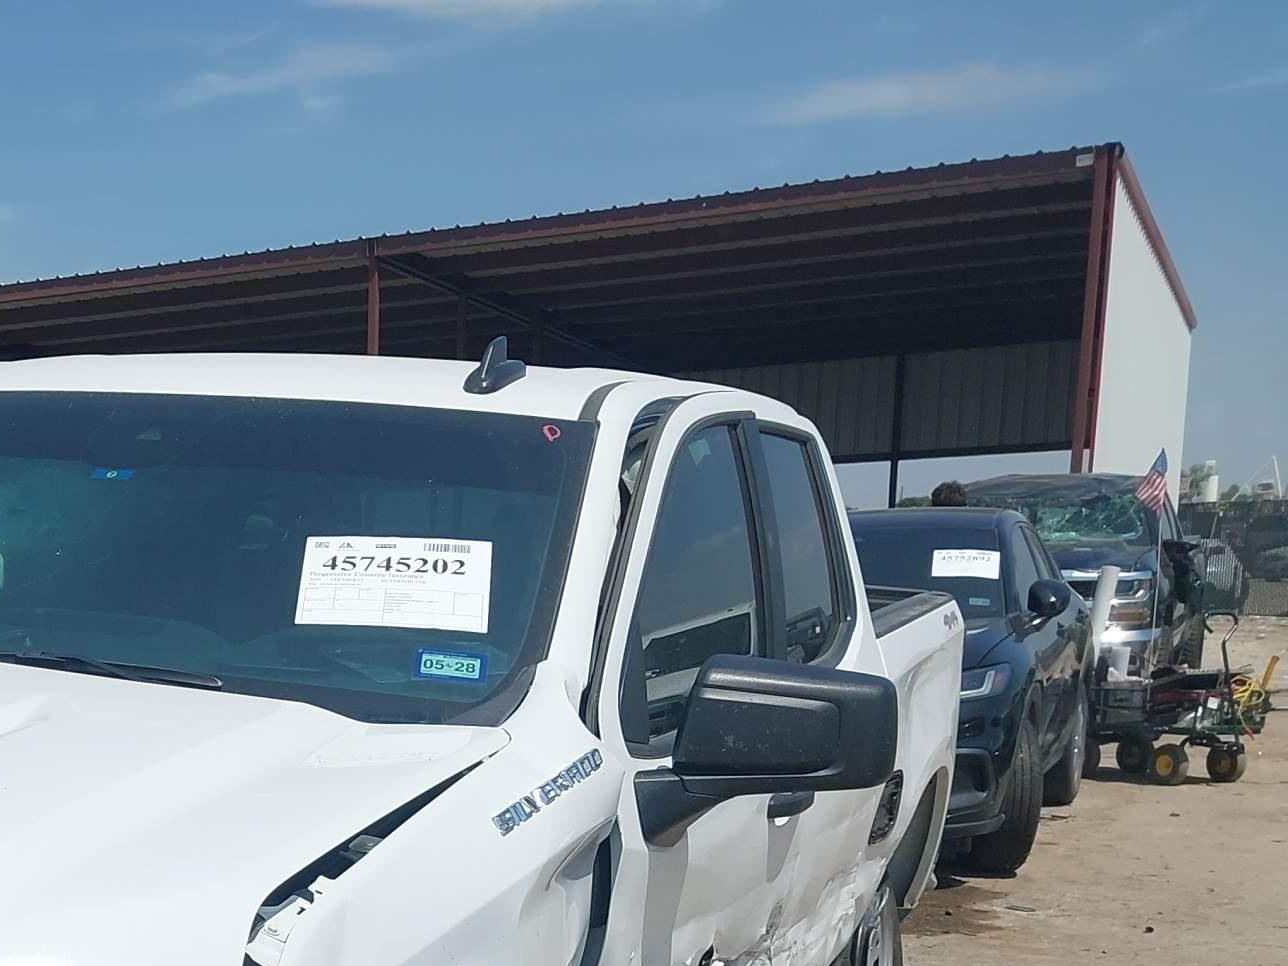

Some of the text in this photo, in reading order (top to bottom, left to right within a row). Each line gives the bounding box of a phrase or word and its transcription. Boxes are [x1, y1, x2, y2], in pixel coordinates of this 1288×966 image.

[322, 555, 467, 575] 45745202
[423, 659, 476, 674] 05 28
[492, 748, 603, 836] SILVERADO
